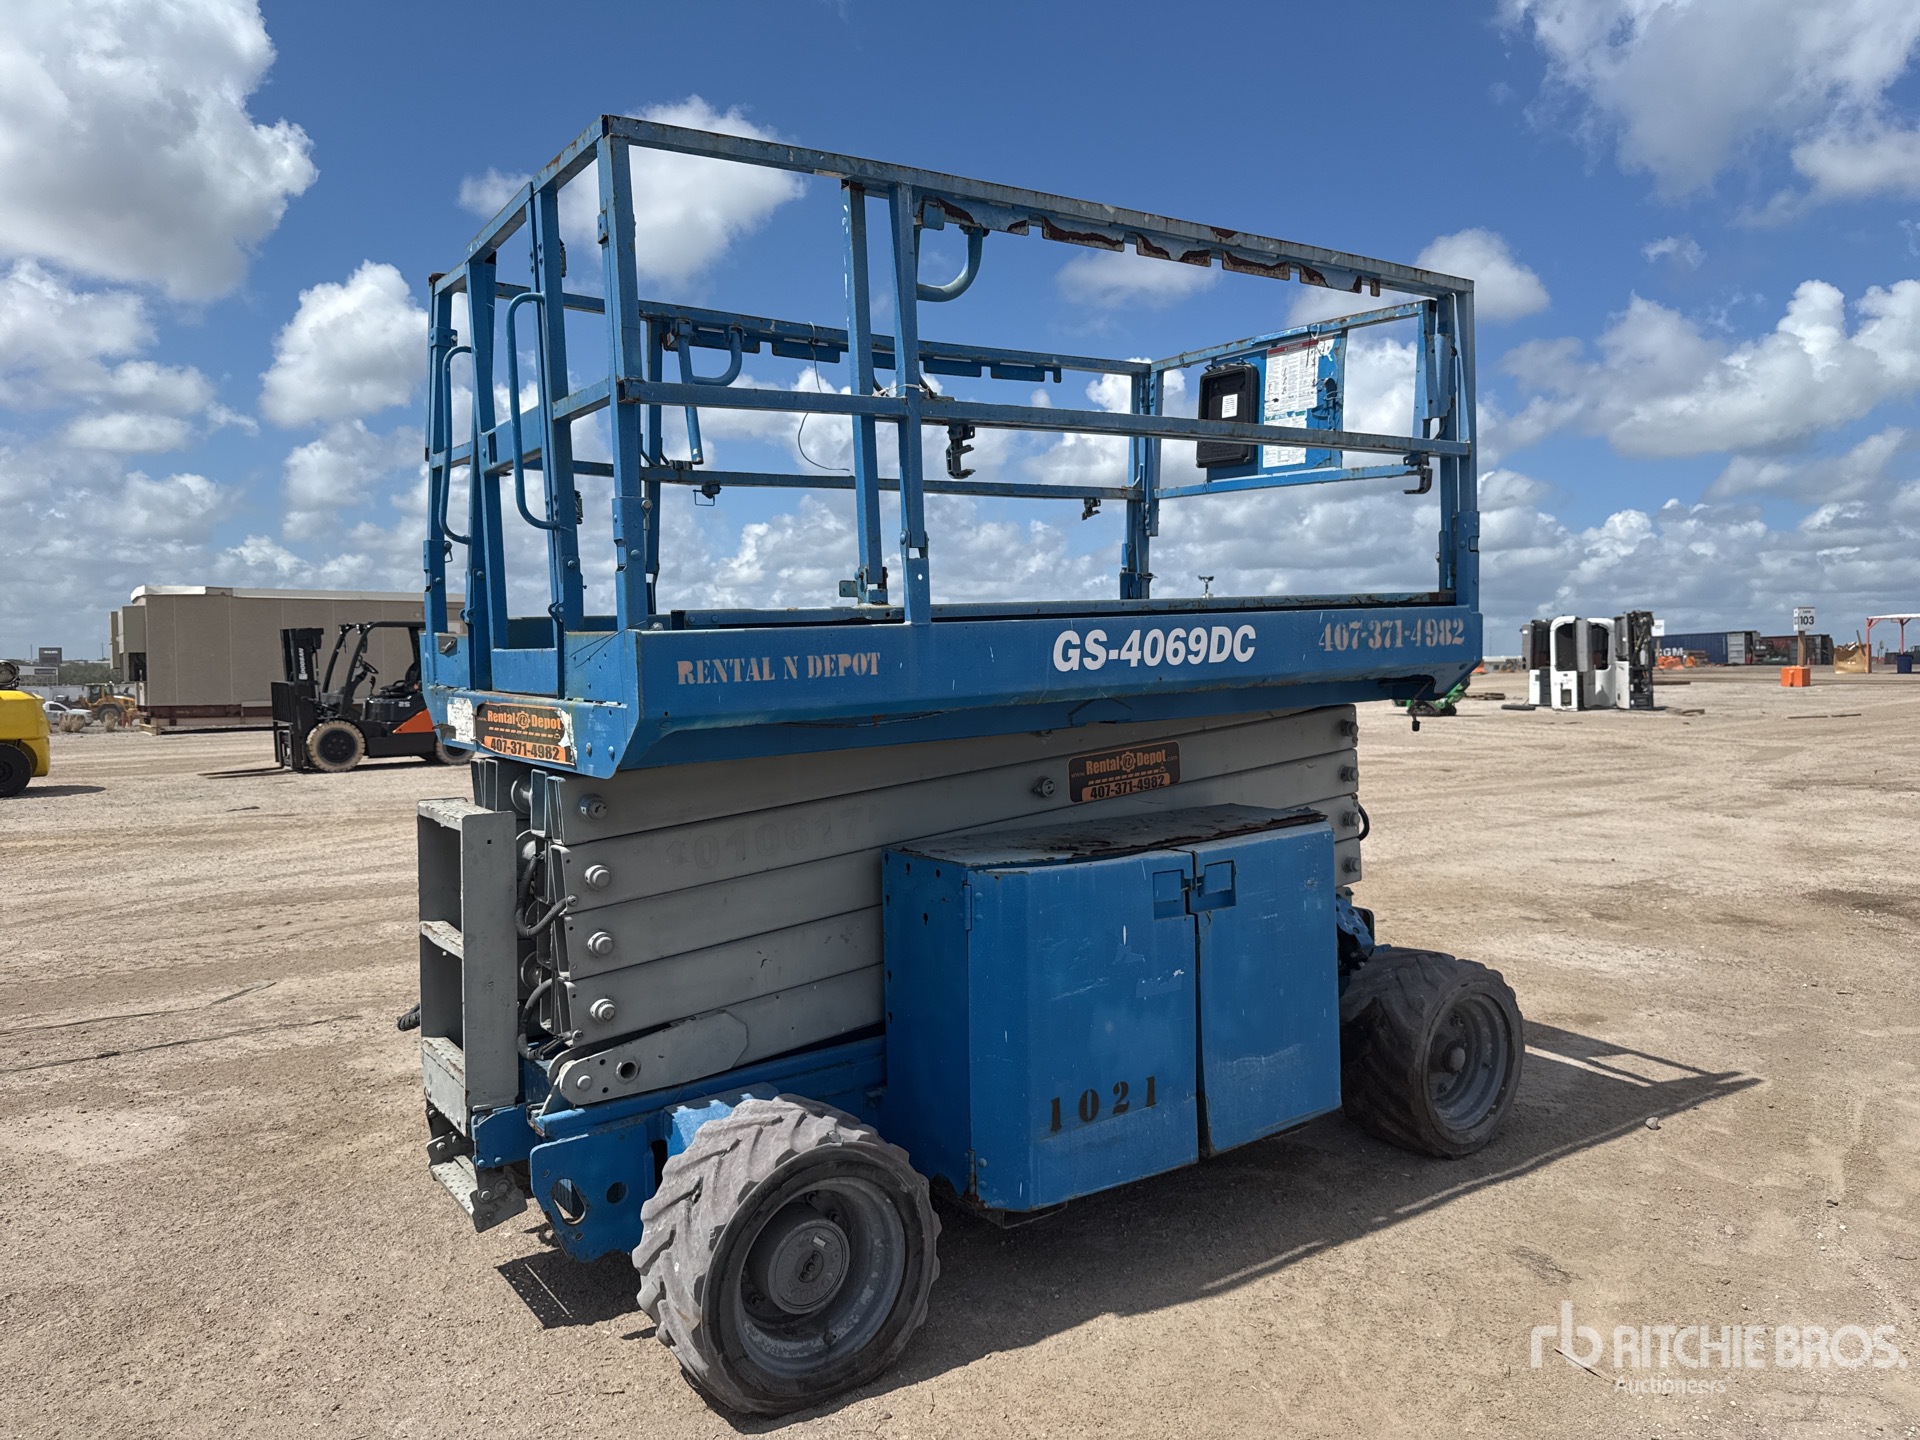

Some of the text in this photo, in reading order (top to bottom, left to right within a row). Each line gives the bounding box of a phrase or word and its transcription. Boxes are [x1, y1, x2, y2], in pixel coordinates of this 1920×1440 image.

[1800, 615, 1815, 625] 103
[1318, 617, 1465, 651] 407-371-4982
[1053, 624, 1256, 672] GS-4069DC
[677, 652, 880, 685] RENTAL N DEPOT
[487, 710, 515, 726] Rental
[531, 714, 562, 730] Depot
[490, 737, 560, 760] 407-371-4982
[1085, 756, 1120, 775] Rental
[1136, 749, 1166, 767] Depot
[1090, 775, 1165, 799] 407-371-4982
[1050, 1076, 1157, 1132] 1021
